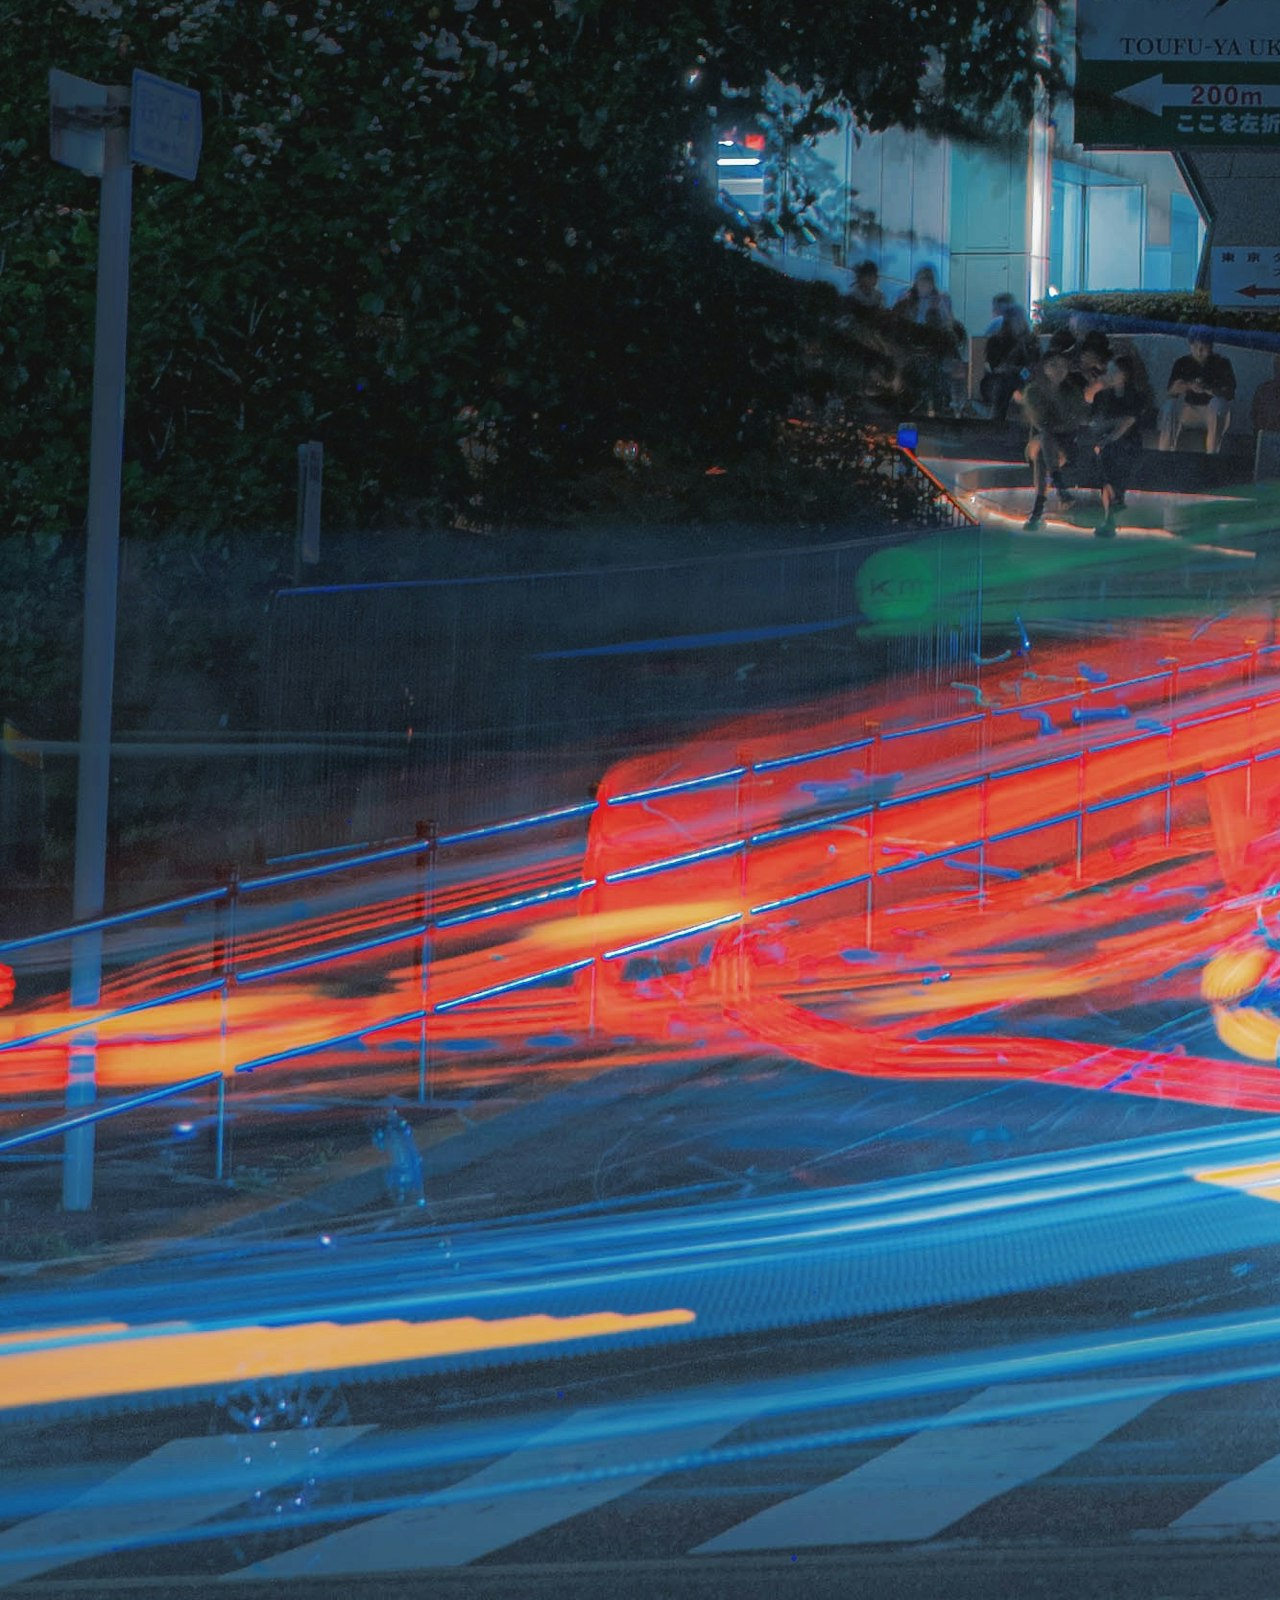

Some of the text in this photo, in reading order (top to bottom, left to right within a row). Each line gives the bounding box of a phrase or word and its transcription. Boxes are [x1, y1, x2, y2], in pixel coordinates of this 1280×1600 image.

[1120, 37, 1242, 56] TOUFU-YA
[1191, 85, 1262, 105] 200m
[1176, 113, 1280, 134] ここを左折
